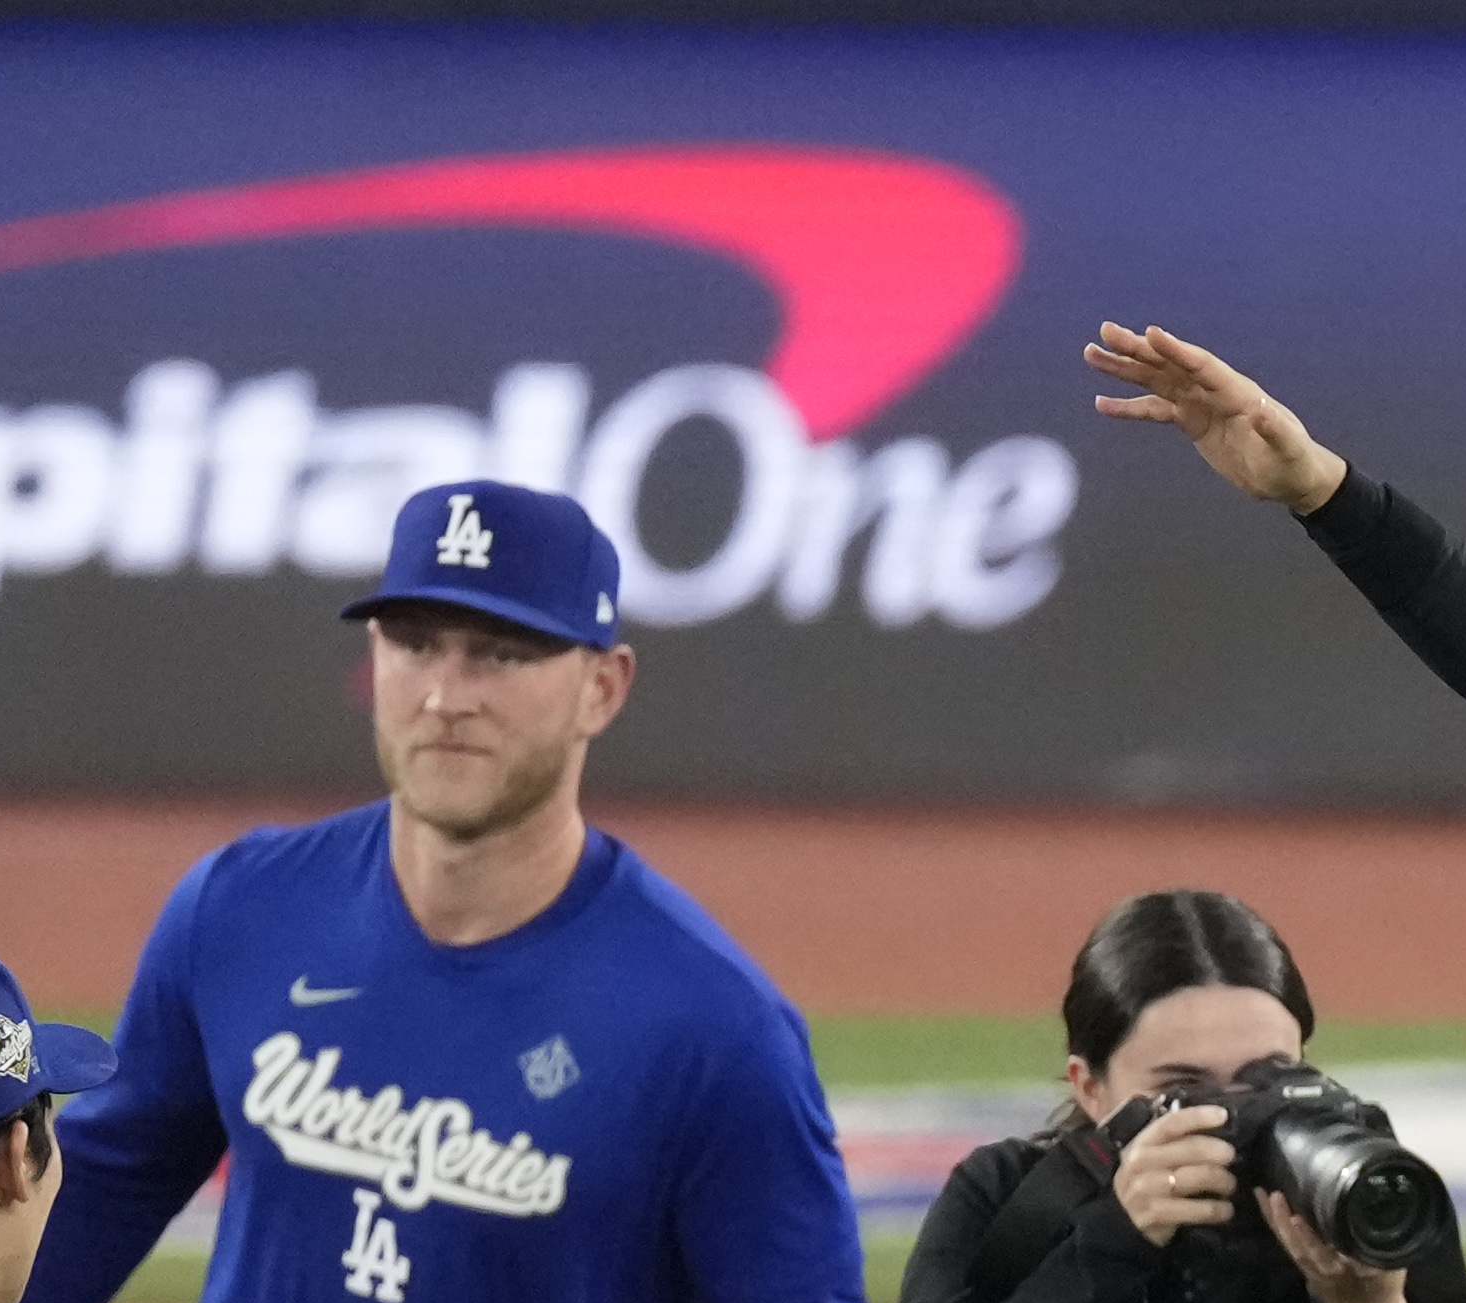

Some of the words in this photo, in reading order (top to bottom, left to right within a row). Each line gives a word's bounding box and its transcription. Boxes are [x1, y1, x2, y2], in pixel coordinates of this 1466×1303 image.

[436, 493, 494, 569] LA
[243, 1031, 423, 1160] World
[383, 1097, 572, 1217] Series
